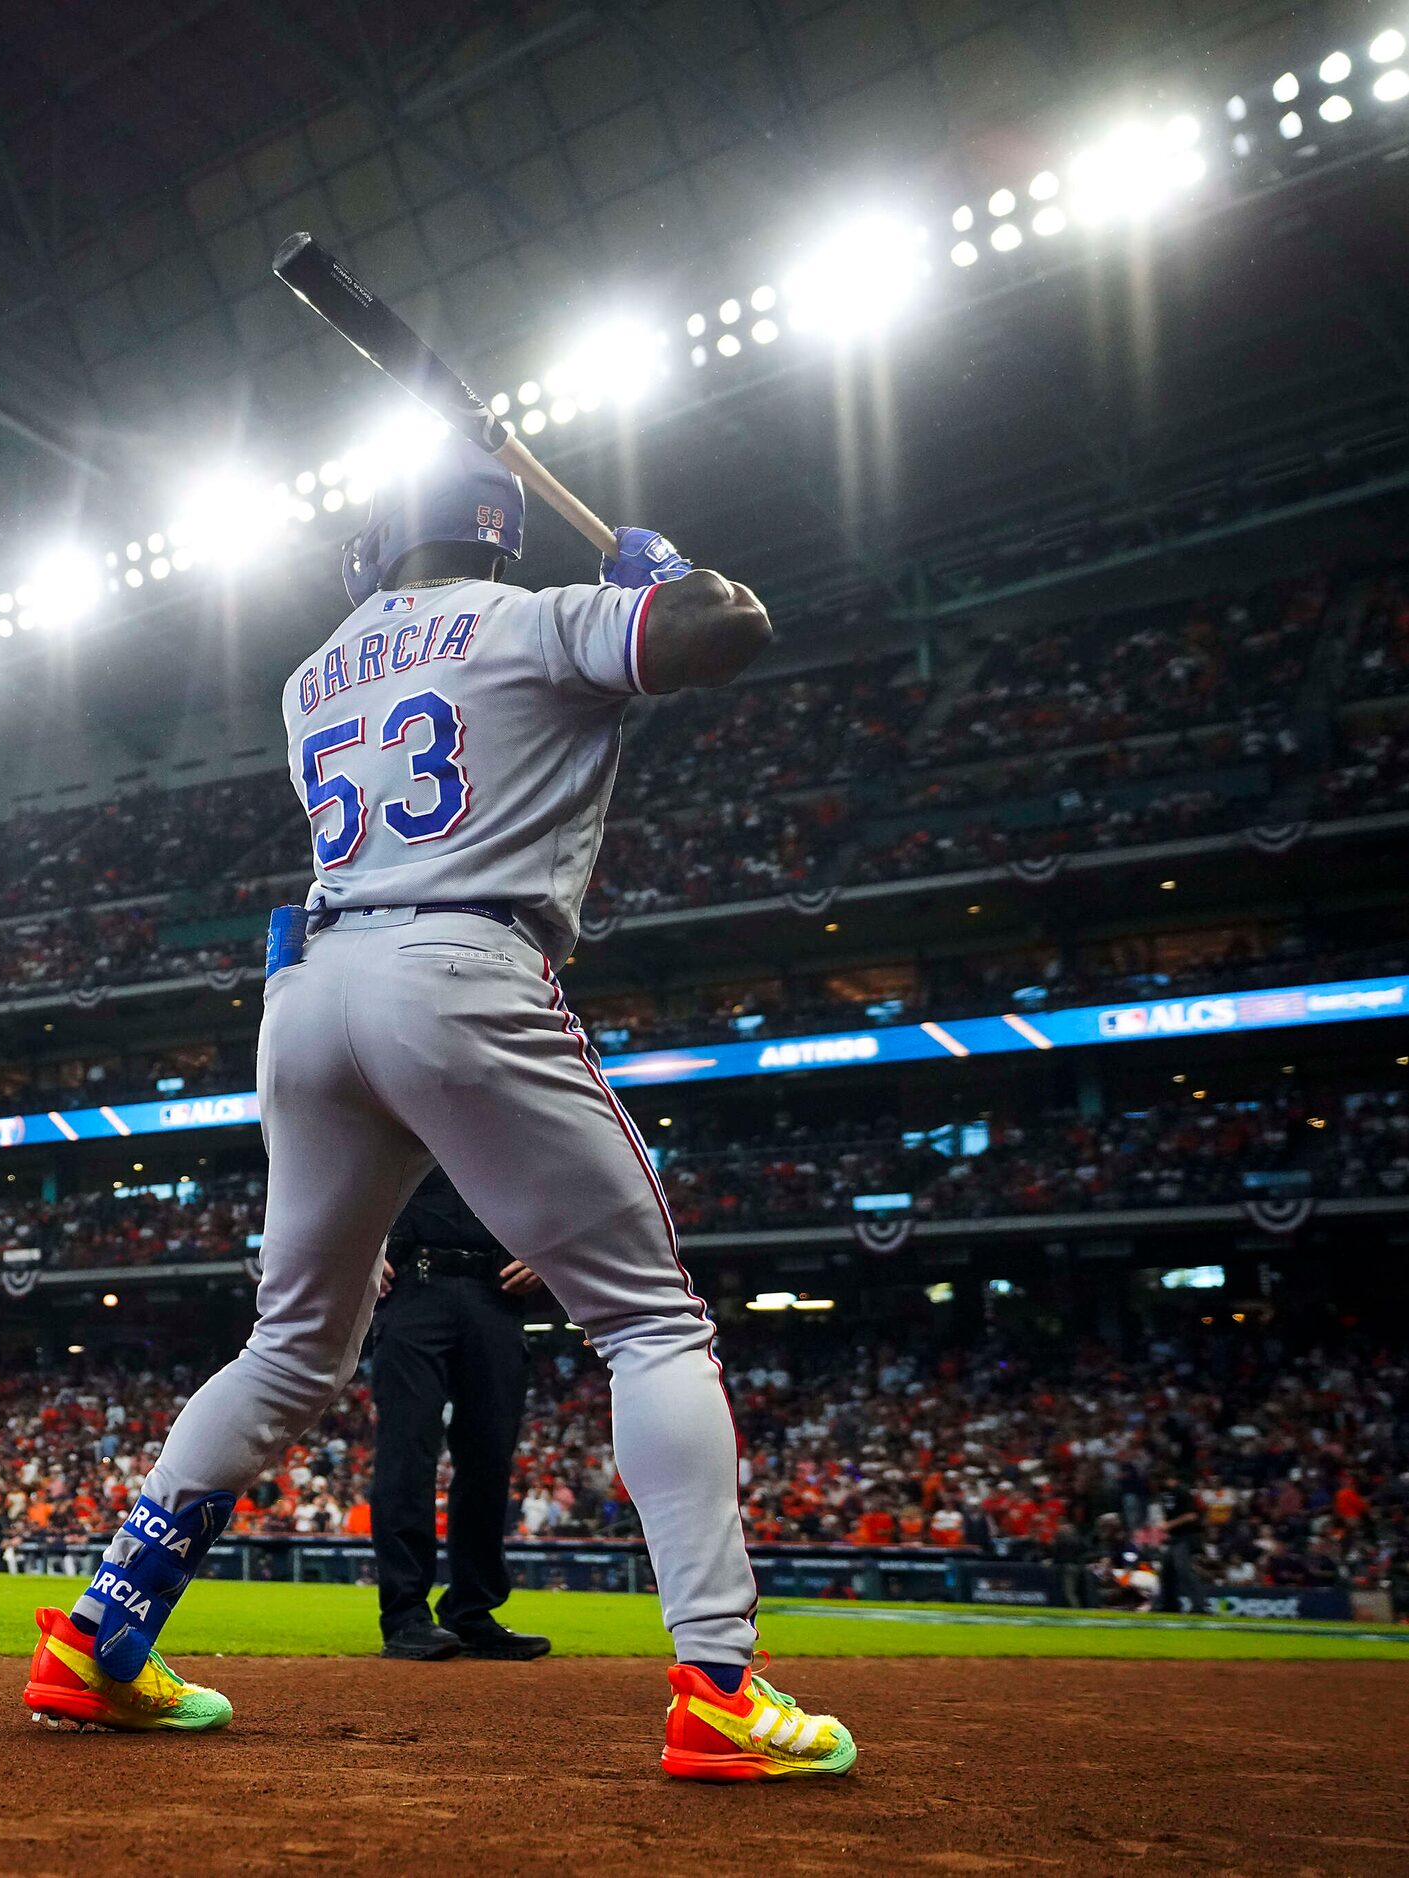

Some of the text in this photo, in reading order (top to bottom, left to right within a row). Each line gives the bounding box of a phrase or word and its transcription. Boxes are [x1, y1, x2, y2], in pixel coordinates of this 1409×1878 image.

[477, 505, 504, 529] 53
[299, 613, 480, 715] GARCIA
[301, 687, 473, 870] 53
[1147, 999, 1237, 1031] ALCS
[758, 1036, 879, 1068] ASTROS
[190, 1097, 244, 1122] ALCS
